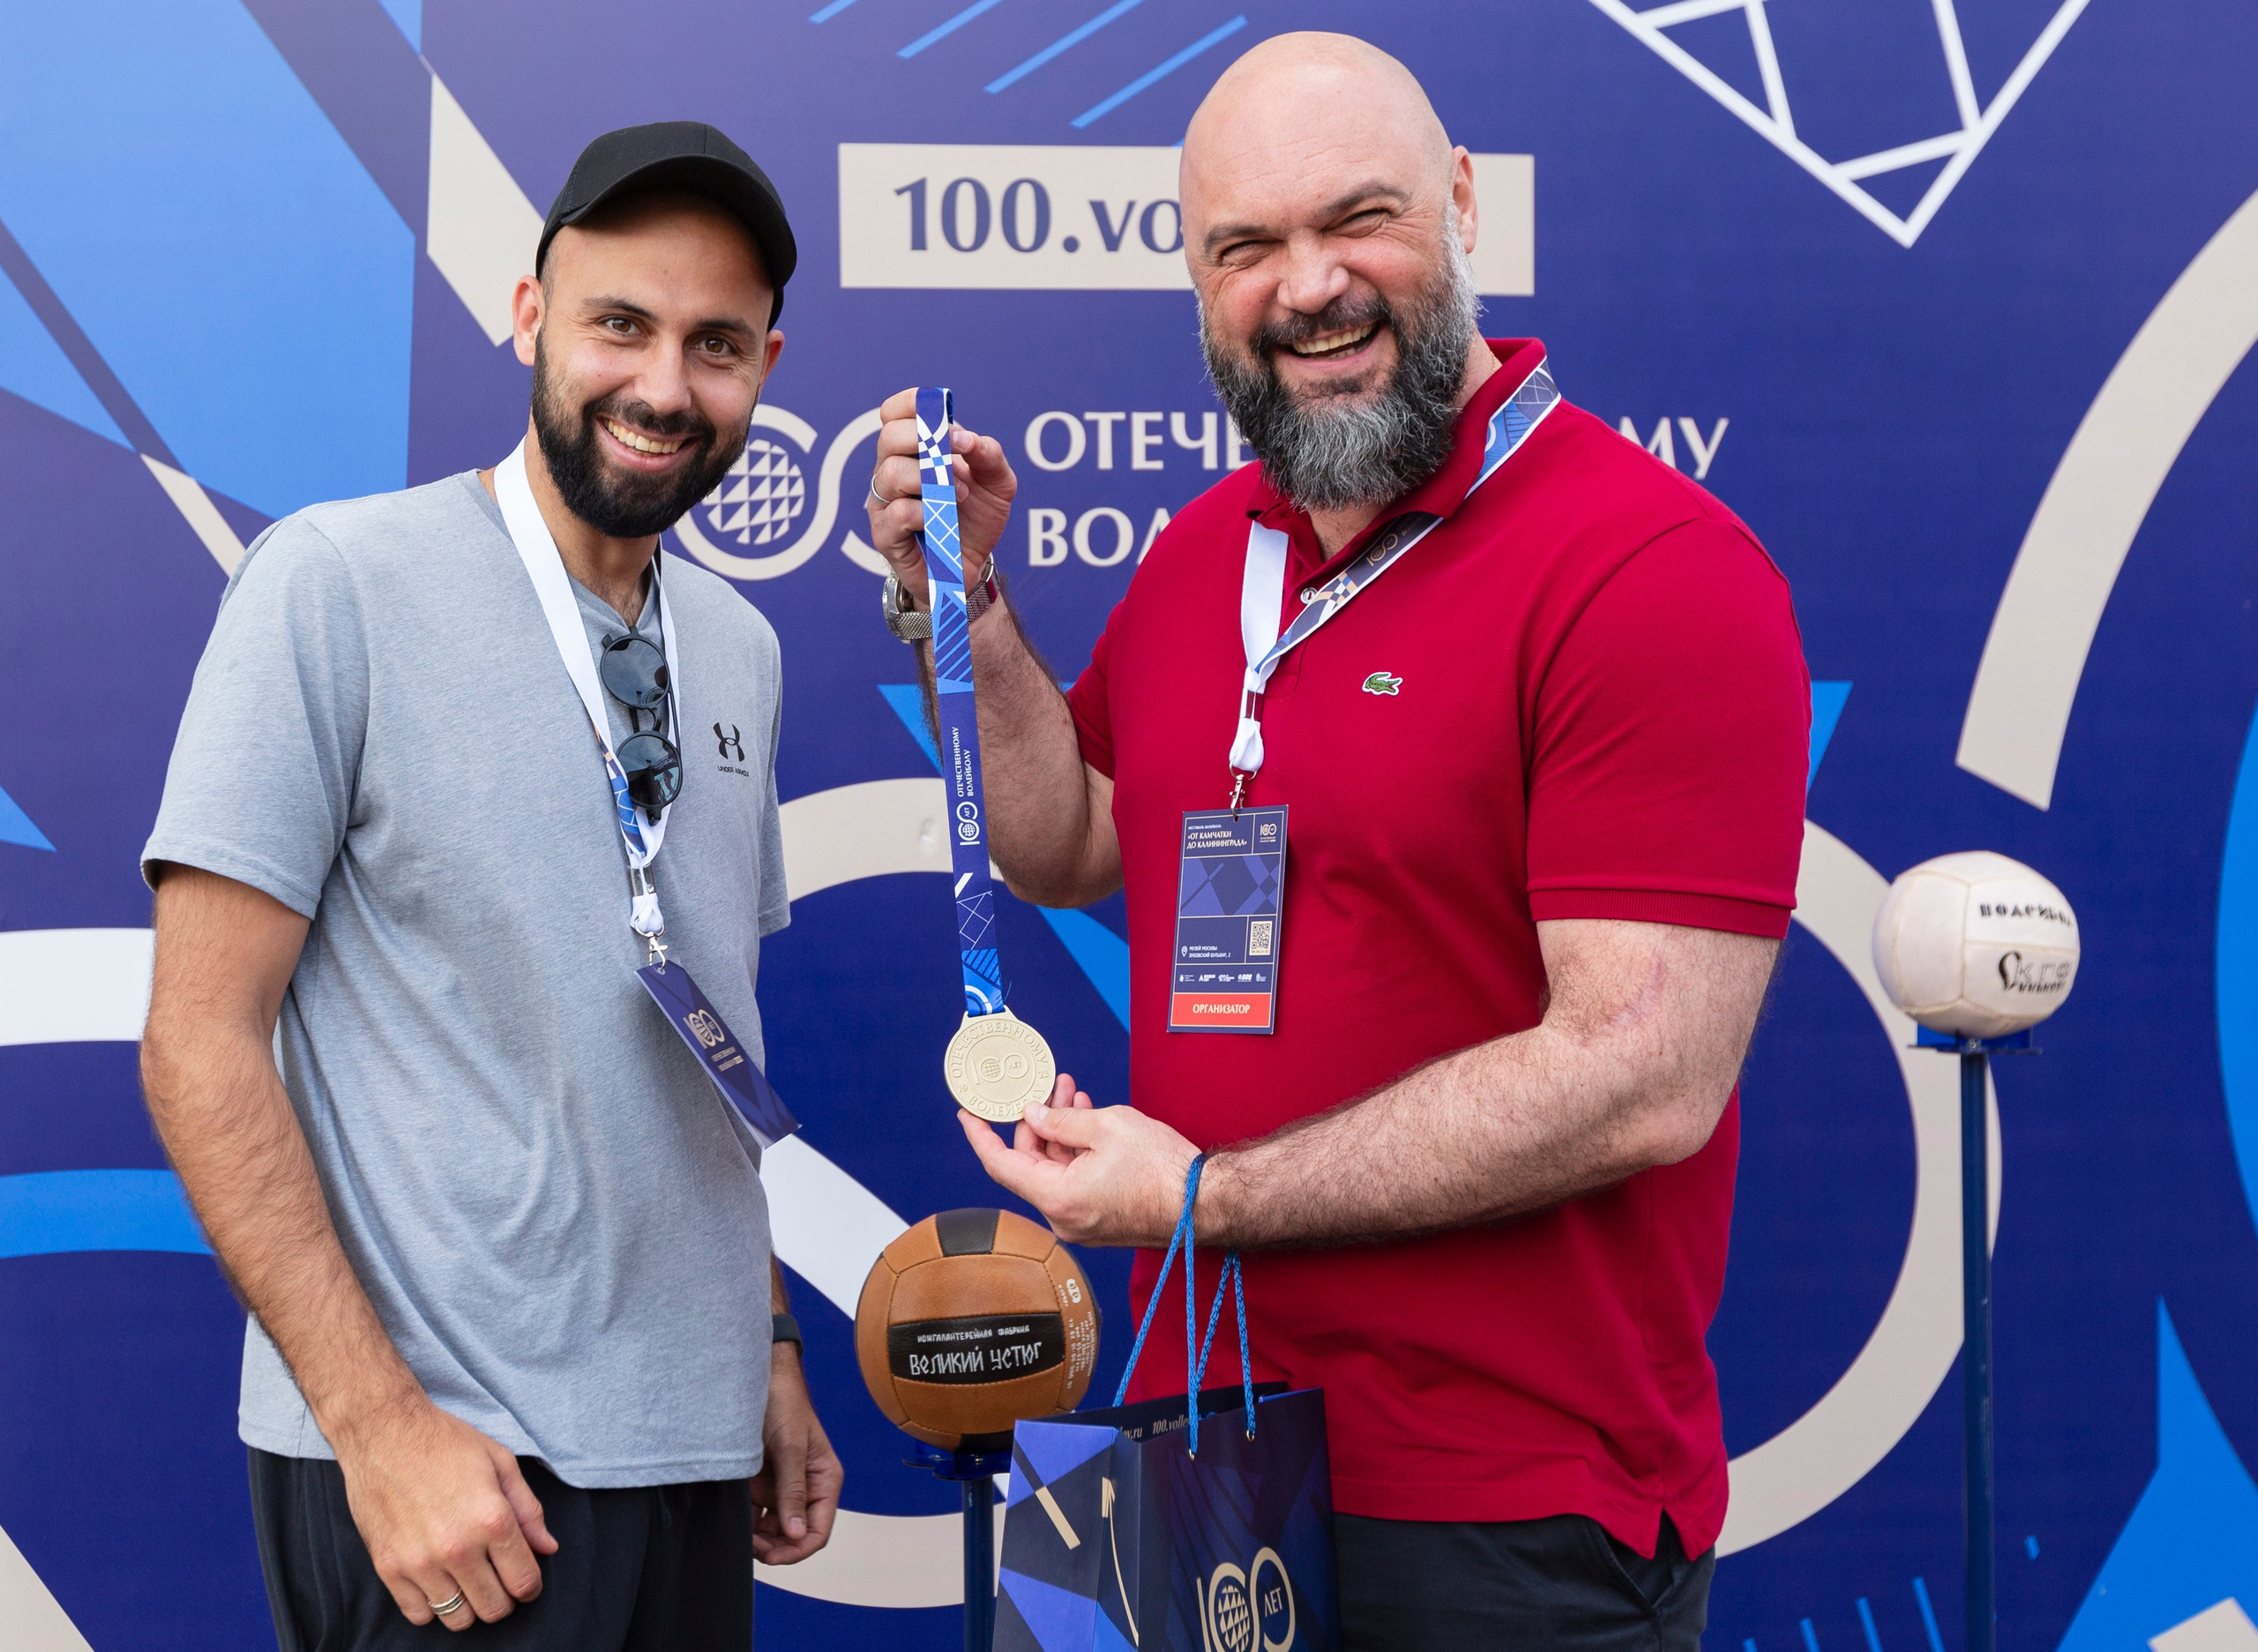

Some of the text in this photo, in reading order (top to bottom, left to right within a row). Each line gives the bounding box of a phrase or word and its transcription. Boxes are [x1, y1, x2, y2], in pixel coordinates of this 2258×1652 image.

[952, 726, 964, 798] ОТЕЧЕСТВЕННОМУ
[963, 749, 975, 797] ВОЛЕЙБОЛУ
[1186, 841, 1197, 850] ДО
[1197, 838, 1248, 849] КАЛИНИНГРАДА»
[1200, 830, 1232, 840] КАМЧАТКИ
[1193, 1003, 1251, 1014] ОРГАНИЗАТОР
[950, 1021, 1049, 1080] ОТЕЧЕСТВЕННОМУ
[917, 1324, 1030, 1343] КОЖГАЛАНТЕРЕЙНАЯ ФАБРИКА
[990, 1341, 1043, 1372] УСТЮГ
[1263, 1587, 1283, 1618] ЛЕТ
